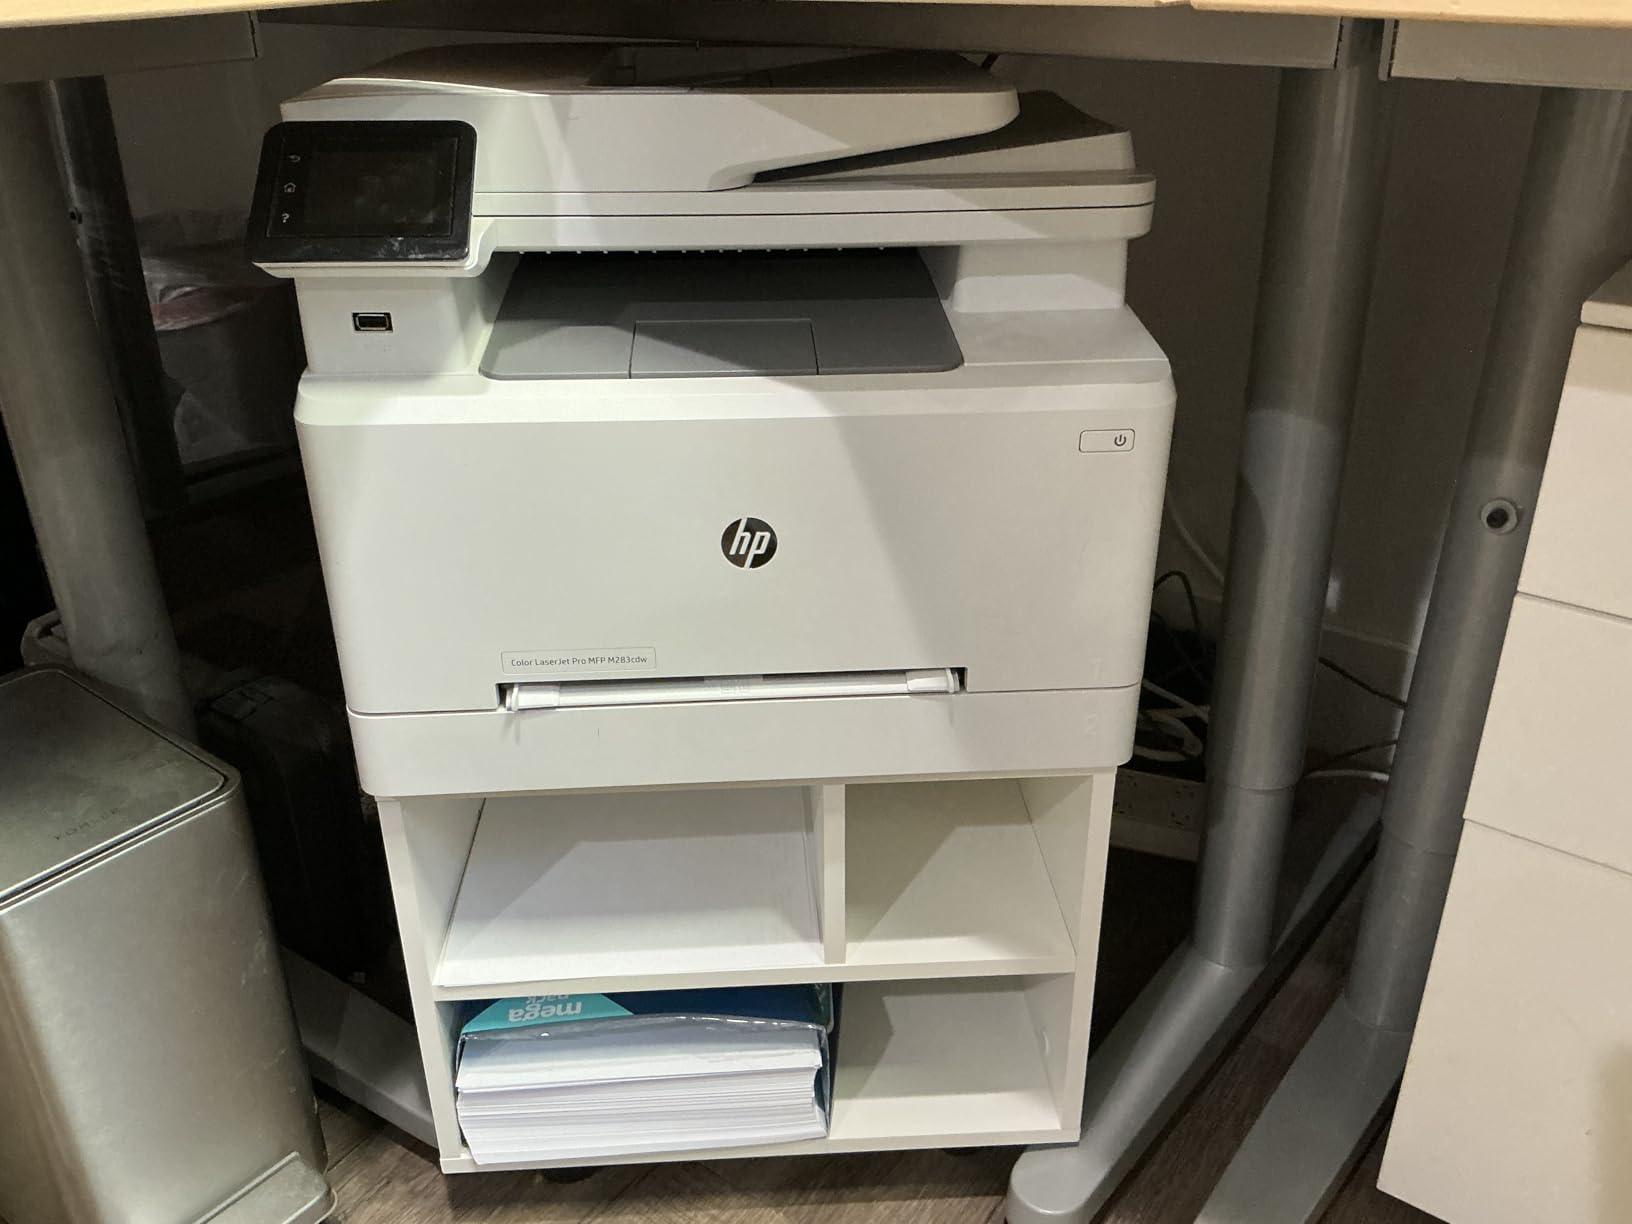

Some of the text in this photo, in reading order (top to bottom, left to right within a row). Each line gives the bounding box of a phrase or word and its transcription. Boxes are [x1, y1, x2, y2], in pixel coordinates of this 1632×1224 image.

[728, 516, 771, 570] hp
[511, 655, 648, 667] Color LaserJet Pro MFP M283cdw
[508, 1001, 582, 1022] mega
